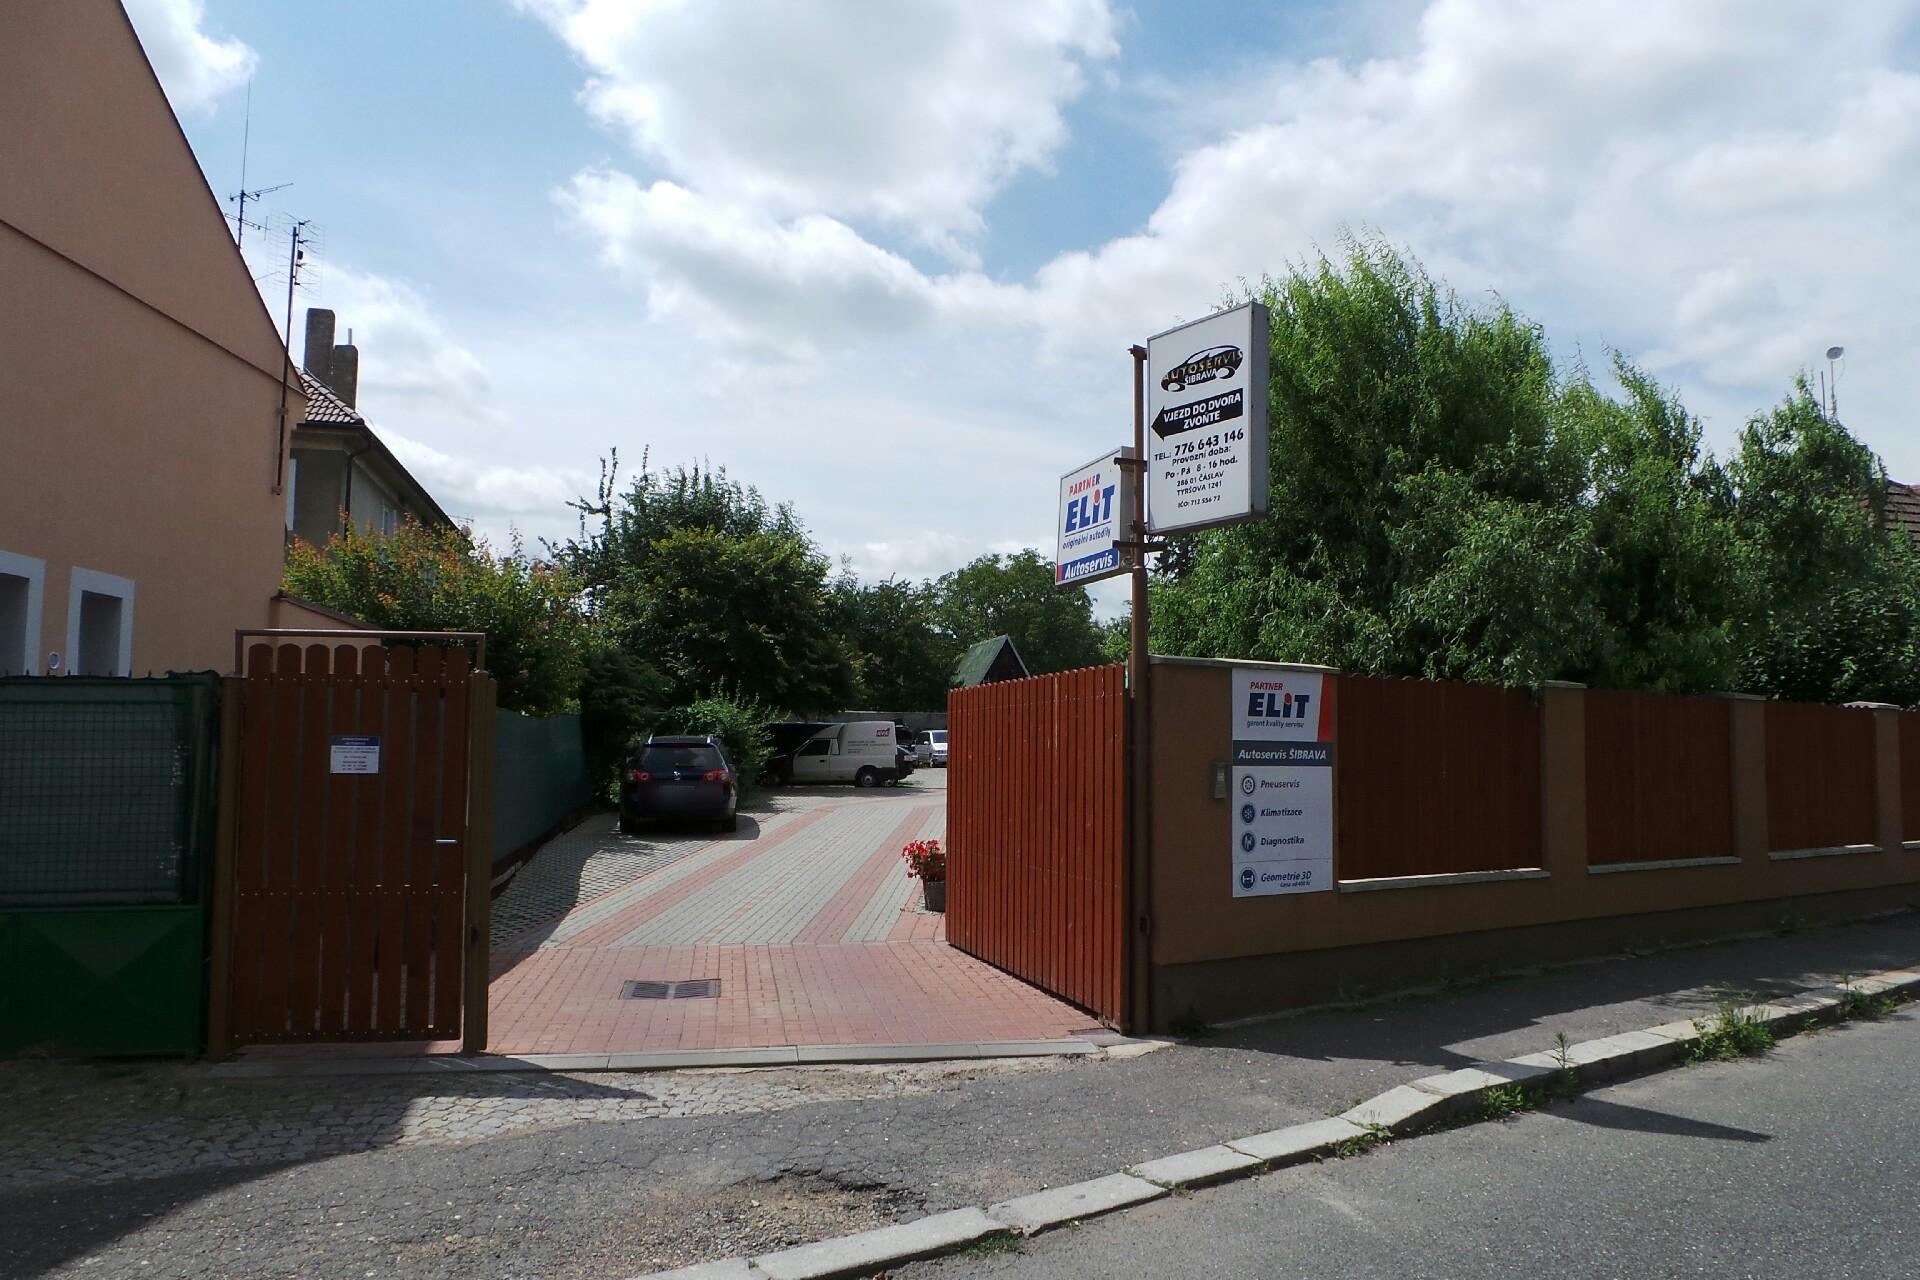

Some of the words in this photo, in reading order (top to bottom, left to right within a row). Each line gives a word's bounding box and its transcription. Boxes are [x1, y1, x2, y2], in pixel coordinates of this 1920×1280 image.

[1163, 350, 1243, 380] AUTOSERVIS
[1184, 368, 1217, 385] ŠIBRAVA
[1163, 407, 1191, 423] VJEZD
[1192, 402, 1207, 416] DO
[1208, 392, 1241, 411] DVORA
[1183, 410, 1221, 429] ZVOŇTE
[1174, 441, 1195, 457] 776
[1197, 434, 1219, 450] 643
[1224, 428, 1244, 444] 146
[1172, 449, 1206, 467] Provozní
[1208, 445, 1232, 457] doba:
[1165, 471, 1176, 479] Po
[1181, 466, 1191, 476] Pá
[1208, 460, 1217, 469] 16
[1219, 455, 1238, 467] hod.
[1068, 473, 1101, 497] PARTNER
[1176, 483, 1206, 497] TYRŠOVA
[1208, 480, 1222, 490] 1241
[1064, 552, 1113, 580] Autoservis
[1250, 681, 1284, 691] PARTNER
[1265, 720, 1285, 729] kvality
[1238, 748, 1287, 760] Autoservis
[1289, 747, 1327, 760] ŠIBRAVA
[1260, 779, 1300, 789] Pneuservis
[1260, 807, 1303, 817] Klimatizace
[1260, 836, 1305, 848] Diagnostika
[1261, 872, 1301, 882] Geometrie
[1302, 870, 1312, 880] 3D
